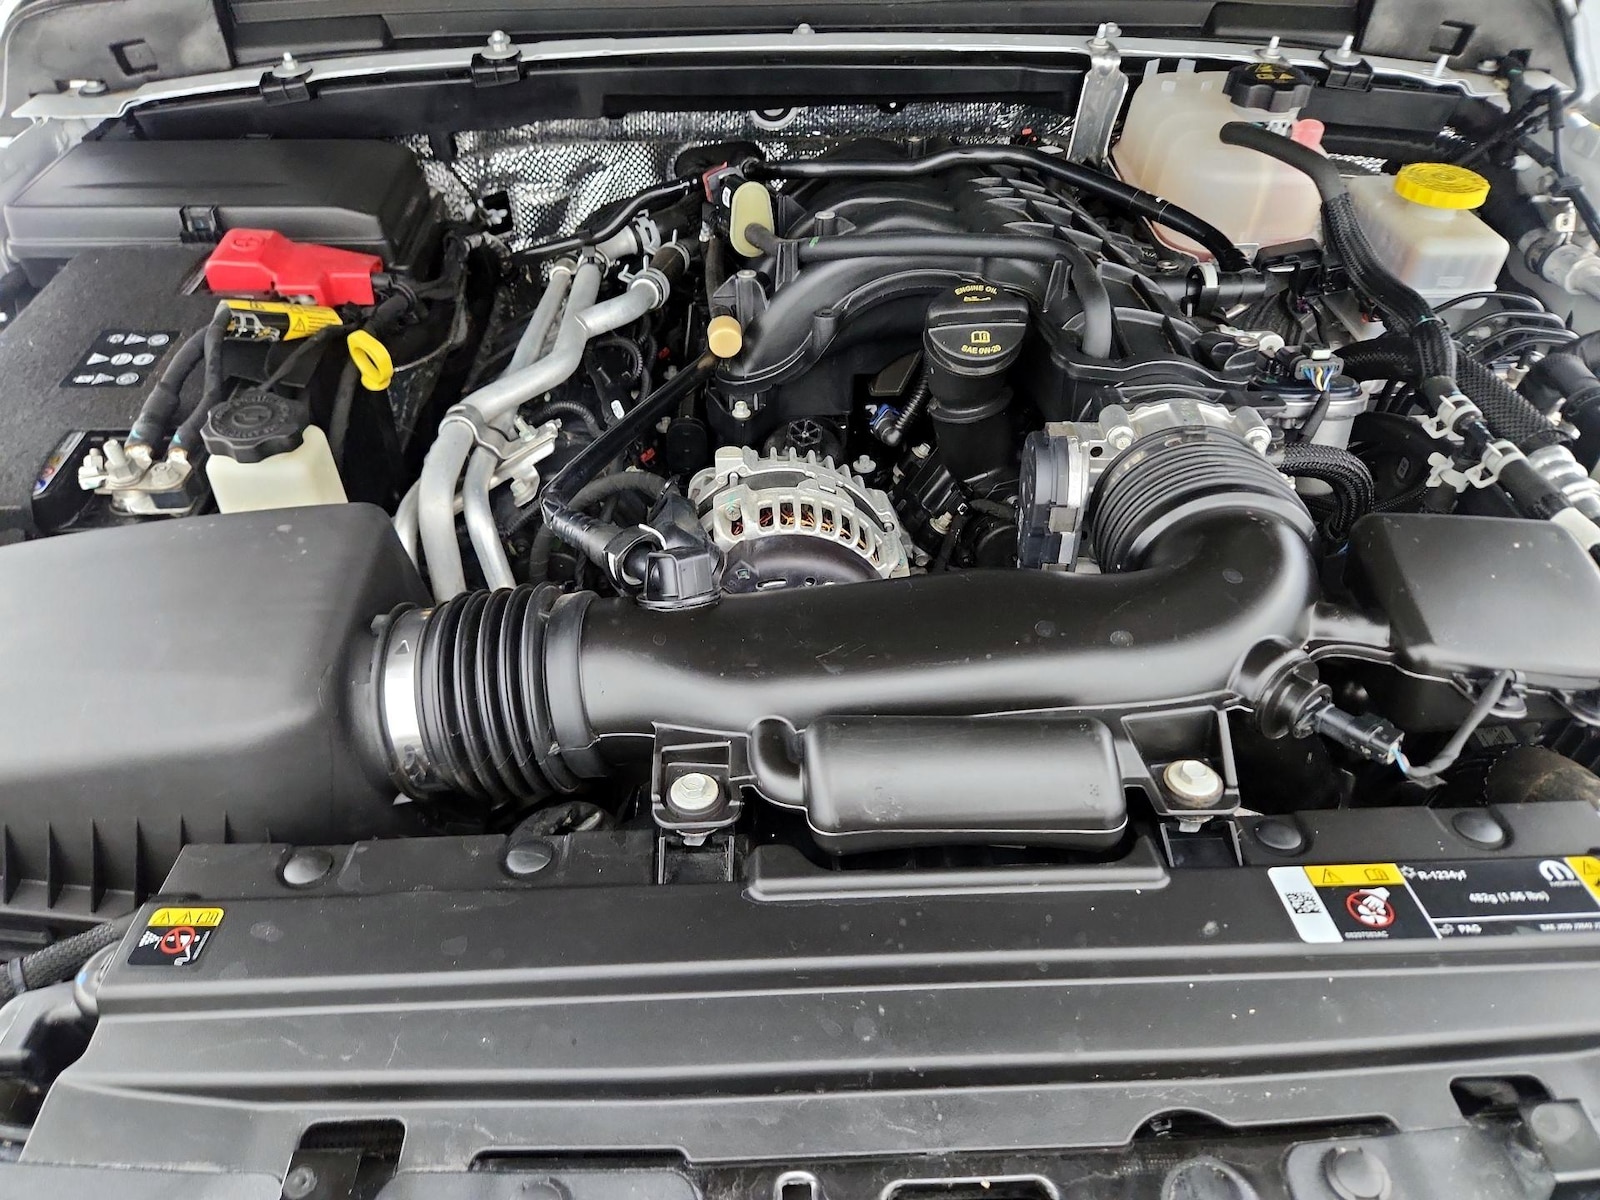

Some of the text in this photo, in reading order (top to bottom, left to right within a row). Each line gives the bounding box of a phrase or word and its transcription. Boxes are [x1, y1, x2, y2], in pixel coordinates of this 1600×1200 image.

[954, 284, 998, 296] ENGINE OIL
[961, 344, 1002, 355] SAE 0W-20
